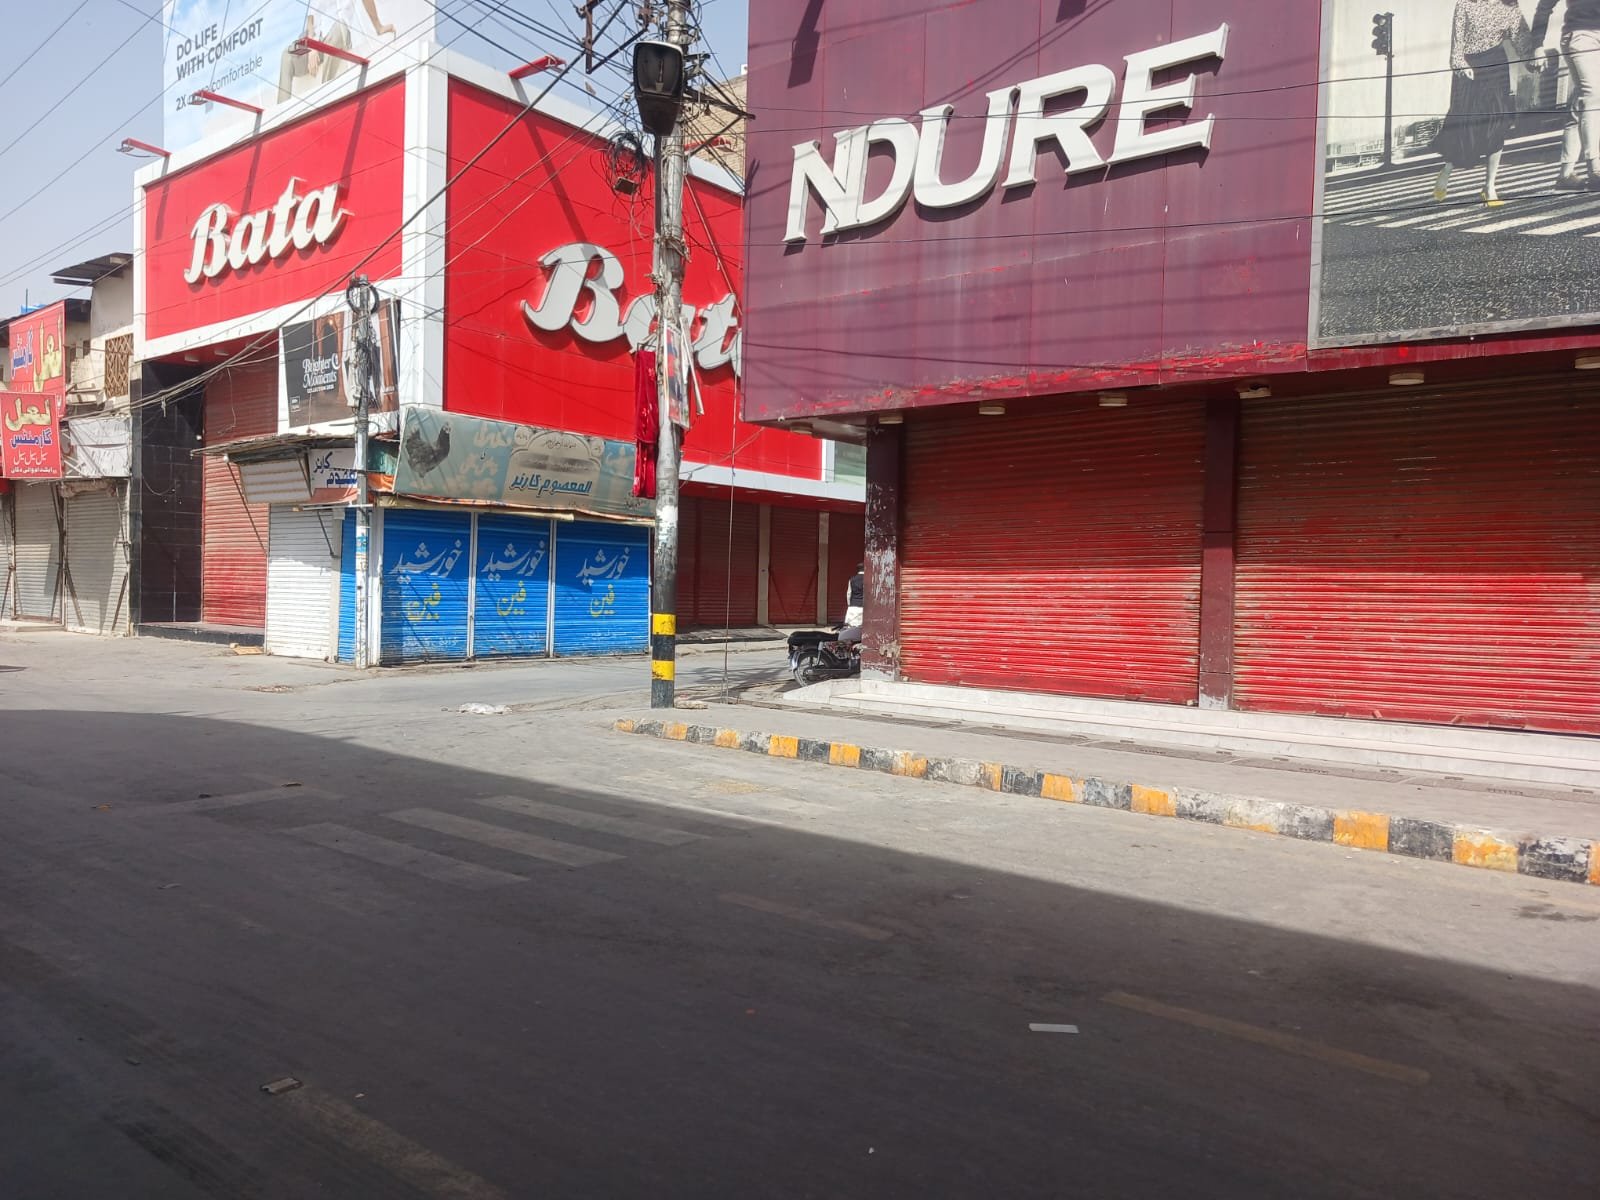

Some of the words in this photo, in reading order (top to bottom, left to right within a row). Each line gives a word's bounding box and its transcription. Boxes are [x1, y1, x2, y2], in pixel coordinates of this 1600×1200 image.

[176, 38, 192, 61] DO
[195, 23, 218, 50] LIFE
[176, 52, 205, 80] WITH
[207, 17, 264, 64] COMFORT
[175, 94, 187, 111] 2X
[210, 54, 263, 92] comfortable
[783, 22, 1230, 244] NDURE
[183, 176, 355, 286] Bata
[519, 241, 742, 378] Bat
[302, 355, 332, 375] Brighter
[302, 371, 337, 388] Moments
[5, 397, 52, 432] لعل
[509, 473, 542, 491] کارنر
[536, 478, 593, 498] المعصوم
[387, 539, 463, 584] خورشید
[481, 540, 546, 582] خورشید
[575, 546, 631, 587] خورشید
